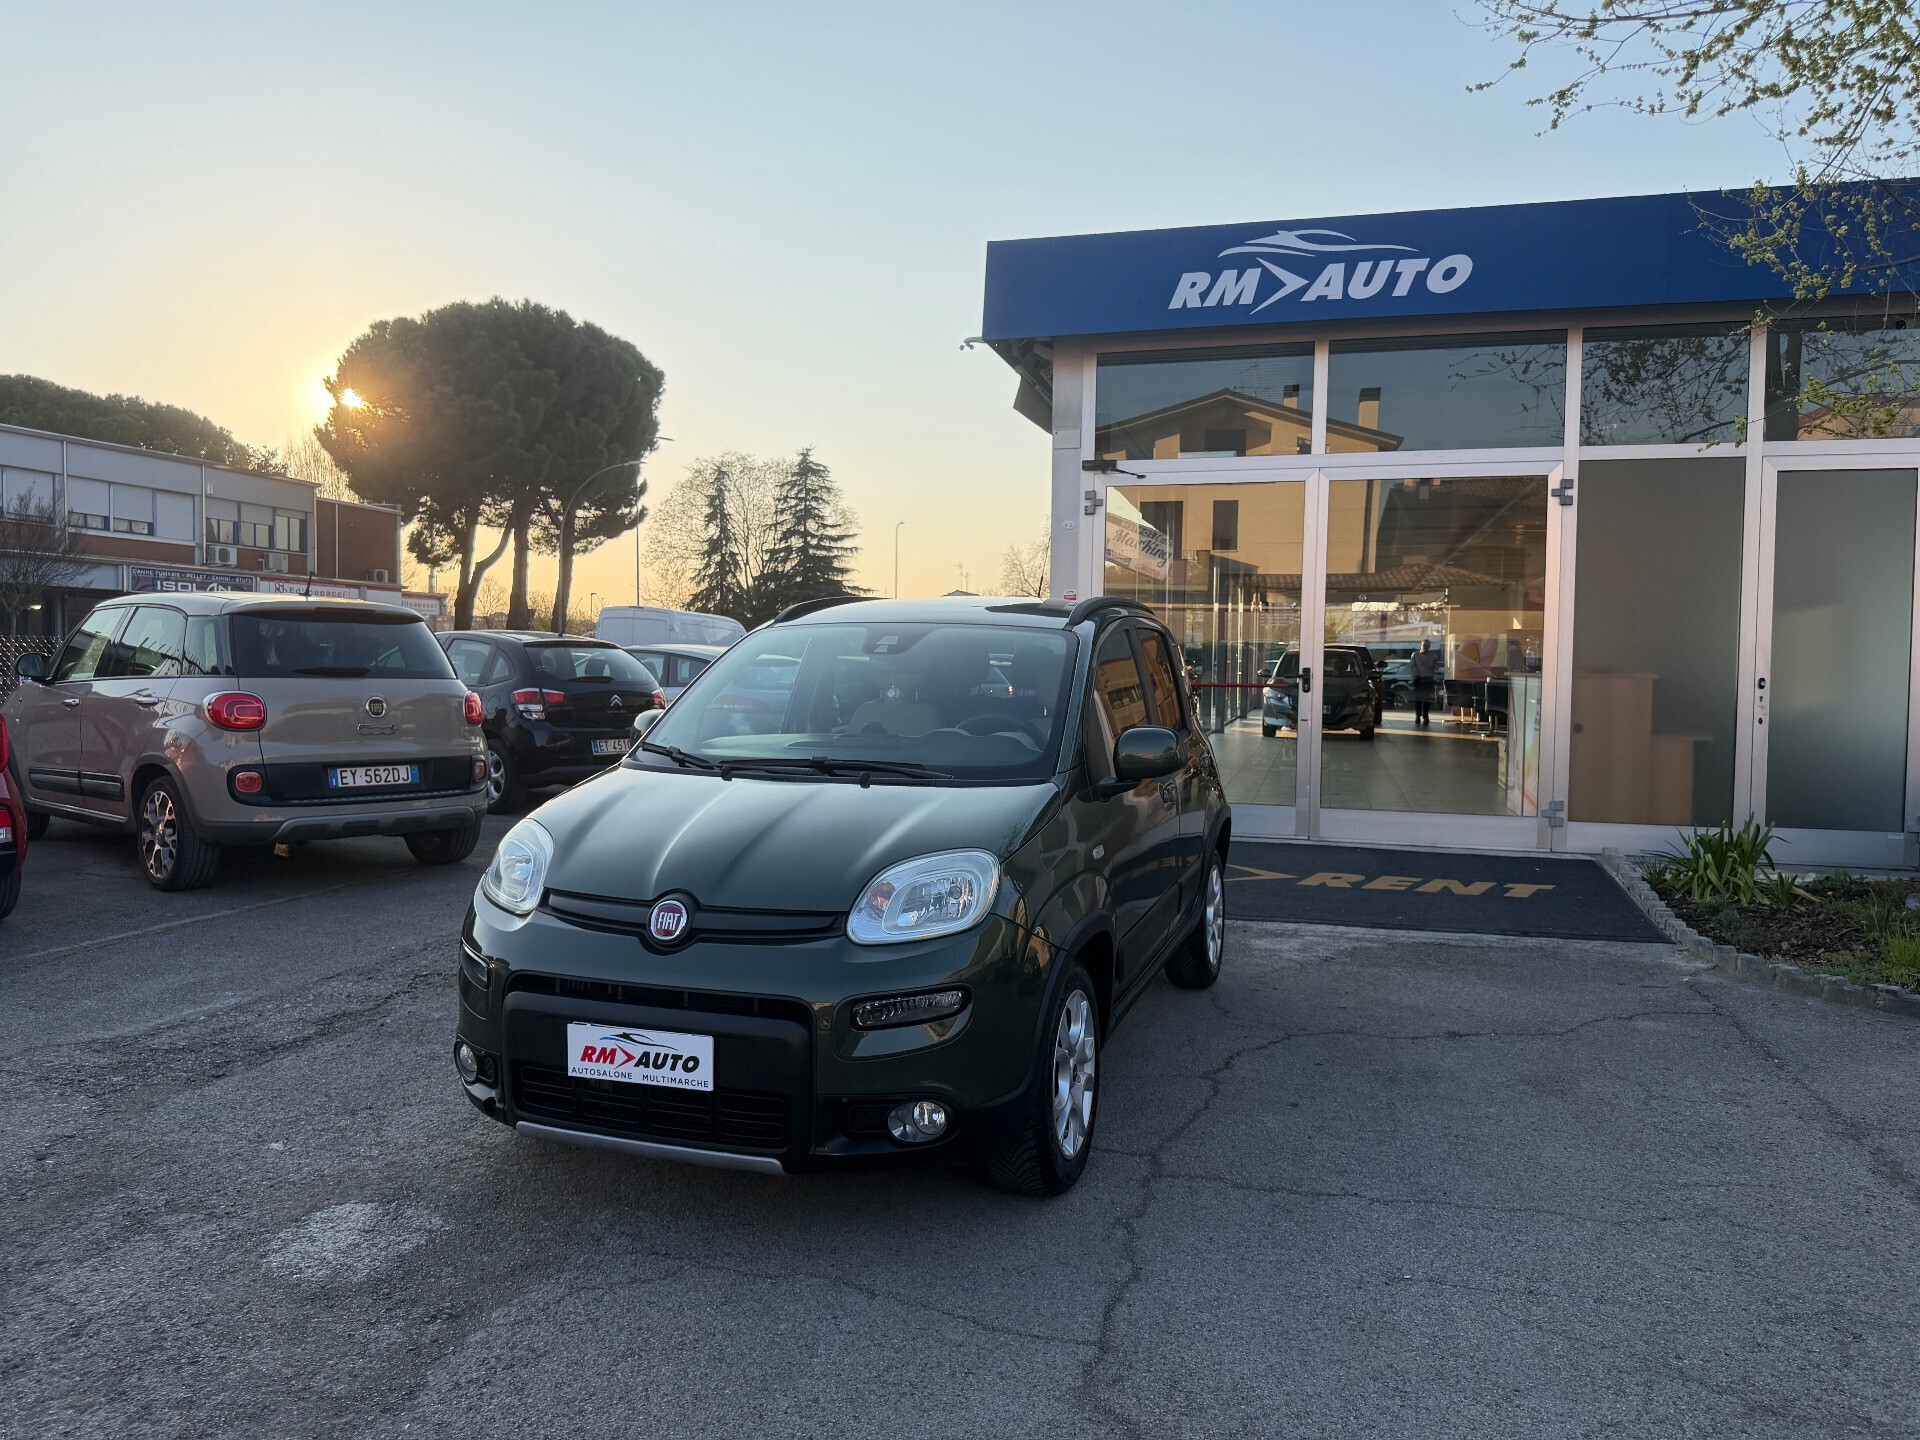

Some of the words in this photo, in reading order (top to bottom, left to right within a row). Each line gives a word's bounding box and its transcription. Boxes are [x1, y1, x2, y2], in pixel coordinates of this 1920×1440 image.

[1168, 267, 1262, 310] RM
[1300, 253, 1474, 302] AUTO
[132, 568, 153, 576] CANNE
[155, 570, 180, 578] FUMARIE
[186, 572, 207, 580] PELLET
[598, 740, 610, 752] ET
[339, 769, 358, 785] EY
[364, 766, 411, 784] 562DJ
[1296, 872, 1557, 898] RENT
[657, 911, 681, 931] FIAT
[580, 1045, 618, 1065] RM
[633, 1050, 700, 1074] AUTO
[571, 1066, 633, 1080] AUTOSALONE
[642, 1073, 709, 1088] MULTIMARCHE
